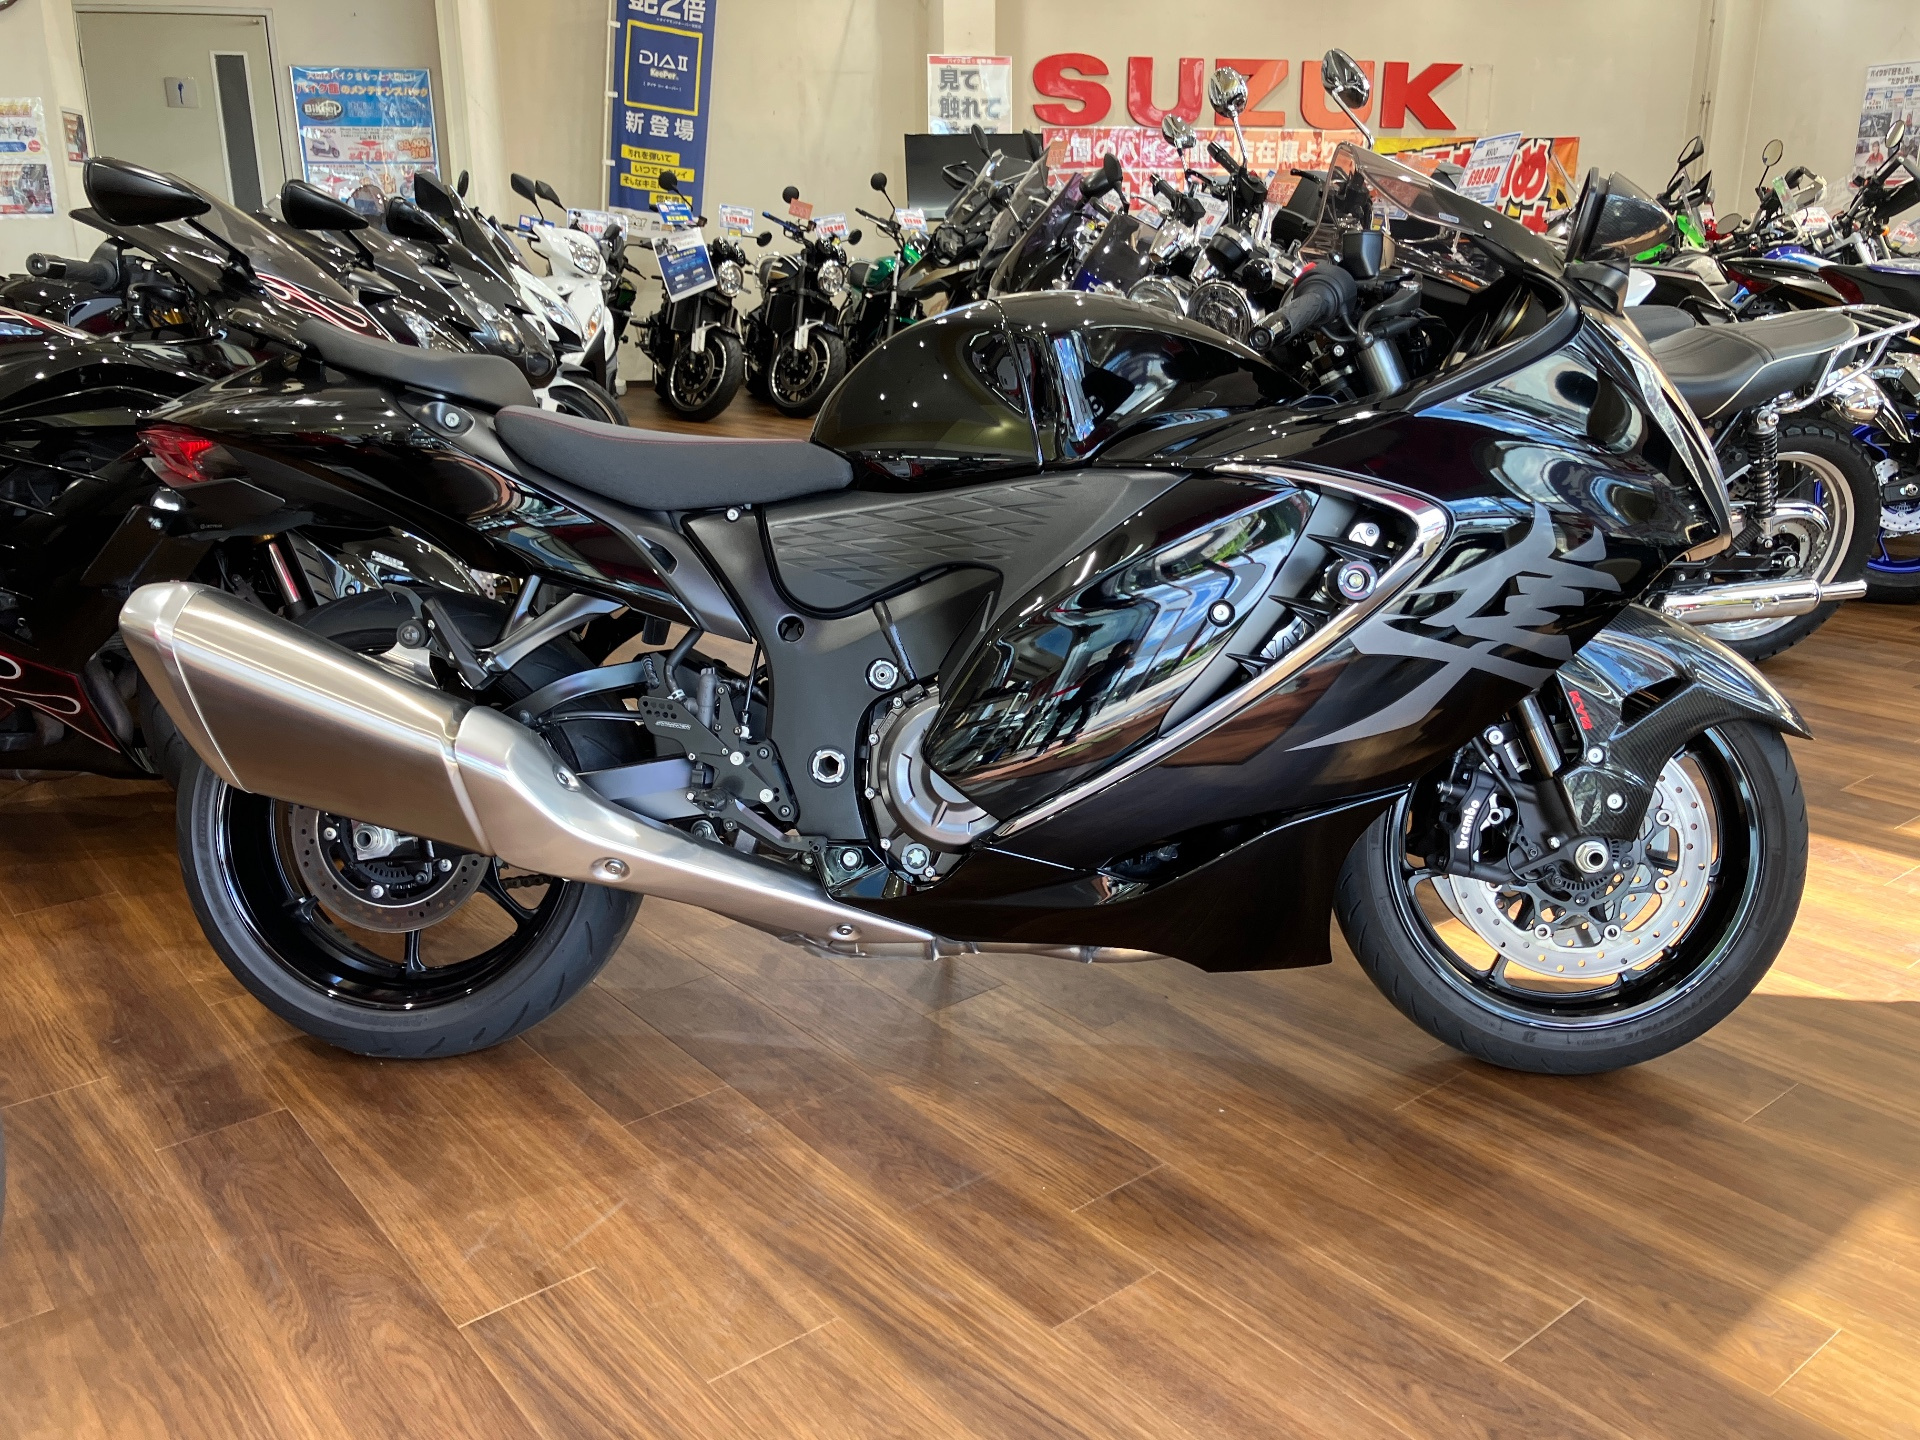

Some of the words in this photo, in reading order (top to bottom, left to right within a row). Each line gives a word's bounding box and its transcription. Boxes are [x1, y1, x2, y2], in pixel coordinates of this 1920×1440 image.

[938, 68, 980, 91] 見て
[939, 96, 1001, 119] 触れて
[625, 109, 694, 142] 新登場
[1456, 799, 1480, 849] brembo
